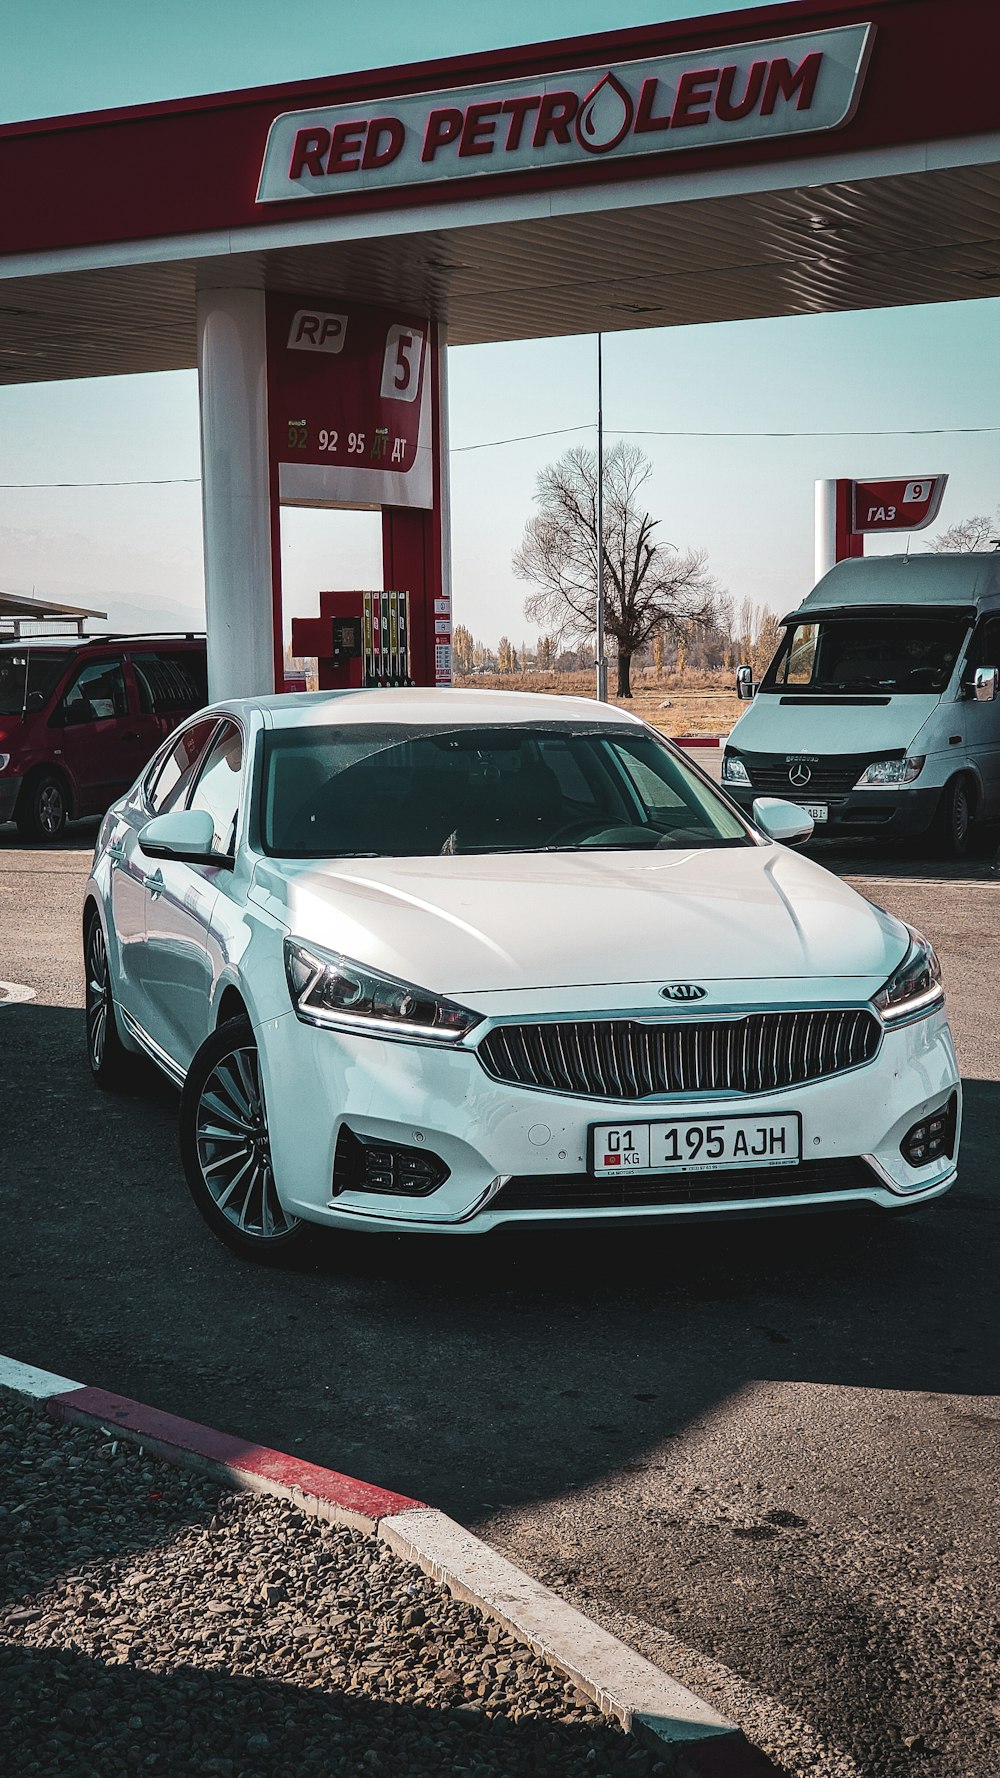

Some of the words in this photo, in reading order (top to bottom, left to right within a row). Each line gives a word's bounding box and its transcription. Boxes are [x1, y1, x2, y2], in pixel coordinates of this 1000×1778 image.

[289, 116, 405, 179] RED
[295, 315, 342, 346] RP
[394, 334, 412, 391] 5
[288, 427, 308, 448] 92
[318, 430, 338, 451] 92
[347, 432, 365, 454] 95
[391, 437, 407, 463] ДТ
[912, 484, 922, 499] 9
[867, 506, 896, 521] ГАЗ
[667, 986, 702, 997] KIA
[608, 1130, 635, 1152] 01
[664, 1126, 725, 1162] 195
[733, 1127, 786, 1157] AJH
[623, 1152, 640, 1165] KG
